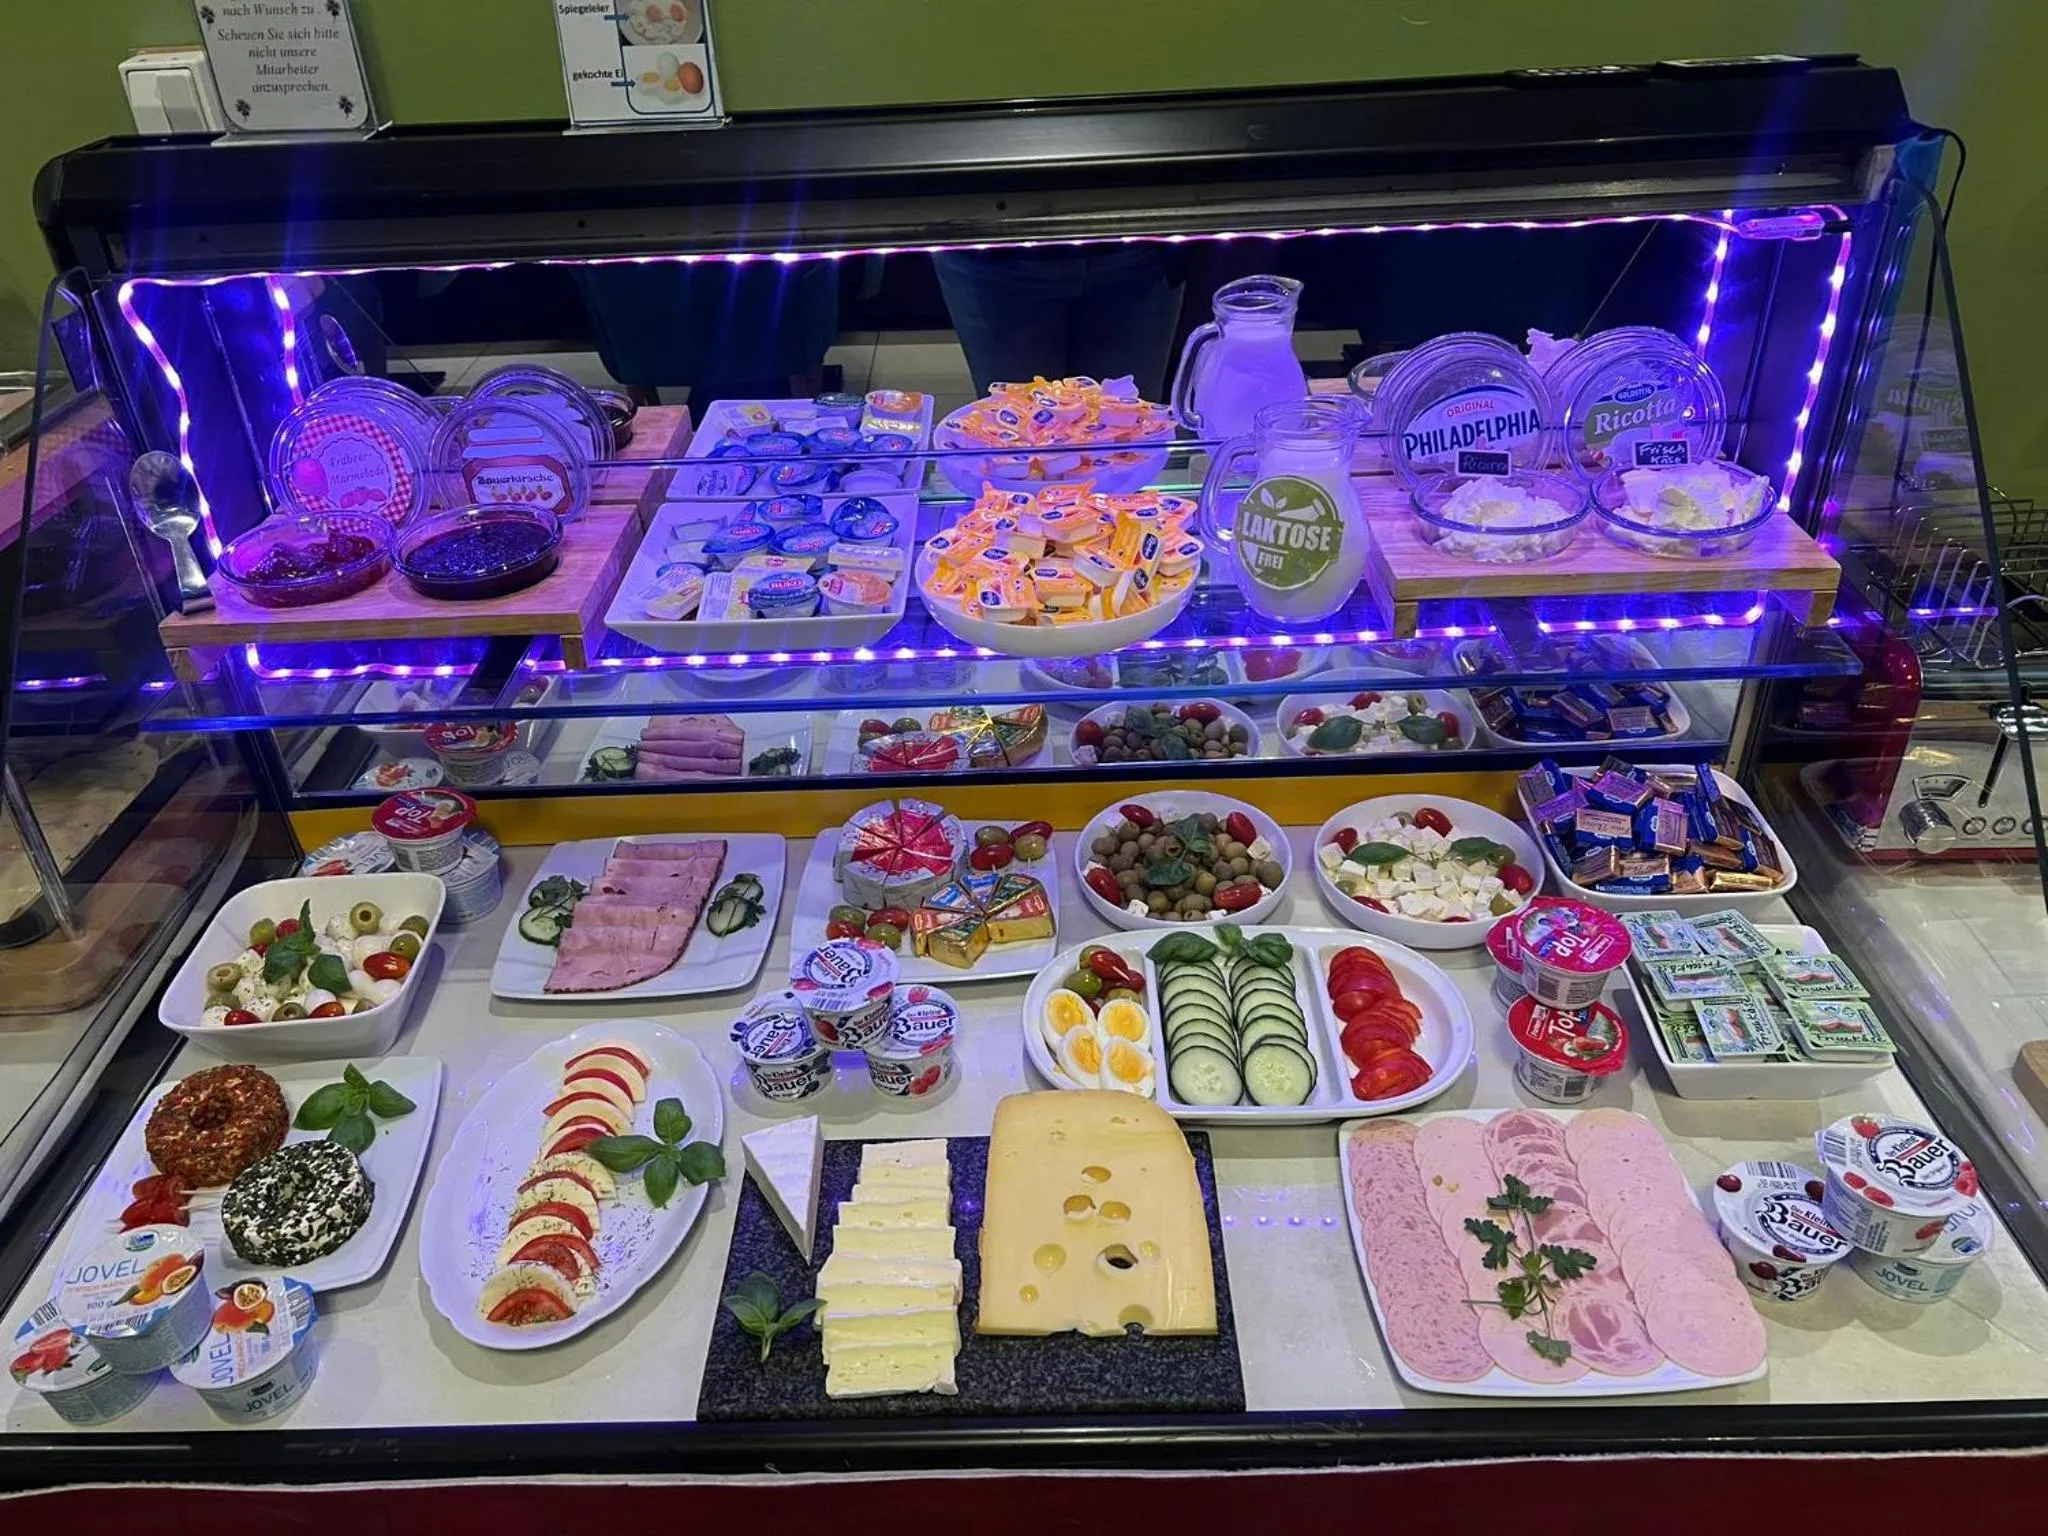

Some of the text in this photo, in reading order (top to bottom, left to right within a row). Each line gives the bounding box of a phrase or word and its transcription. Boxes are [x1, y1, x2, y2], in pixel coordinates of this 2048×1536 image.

[253, 3, 299, 16] Wunsch
[217, 27, 340, 41] Scheuen Sie sich bitte
[248, 46, 317, 58] nicht unsere
[256, 63, 319, 76] Mitarbeiter
[572, 69, 613, 81] gekochte
[1446, 399, 1495, 418] ORIGINAL
[1593, 398, 1677, 435] Ricotta
[1402, 408, 1541, 460] PHILADELPHIA
[1639, 442, 1686, 456] Frisch
[1242, 511, 1333, 552] LAKTOSE
[1258, 551, 1284, 570] FREI
[817, 944, 863, 988] Bauer
[750, 1013, 801, 1058] Bauer
[892, 1016, 957, 1035] Bauer
[754, 1071, 815, 1093] Bauer
[1891, 1136, 1919, 1152] Kleine
[1876, 1139, 1950, 1187] Bauer
[1755, 1202, 1848, 1250] Bauer
[1790, 1205, 1831, 1229] Der Klein
[65, 1258, 145, 1285] JOVEL
[1875, 1268, 1929, 1292] JOVEL
[208, 1332, 234, 1385] JOVEL
[242, 1383, 295, 1413] JOVEL
